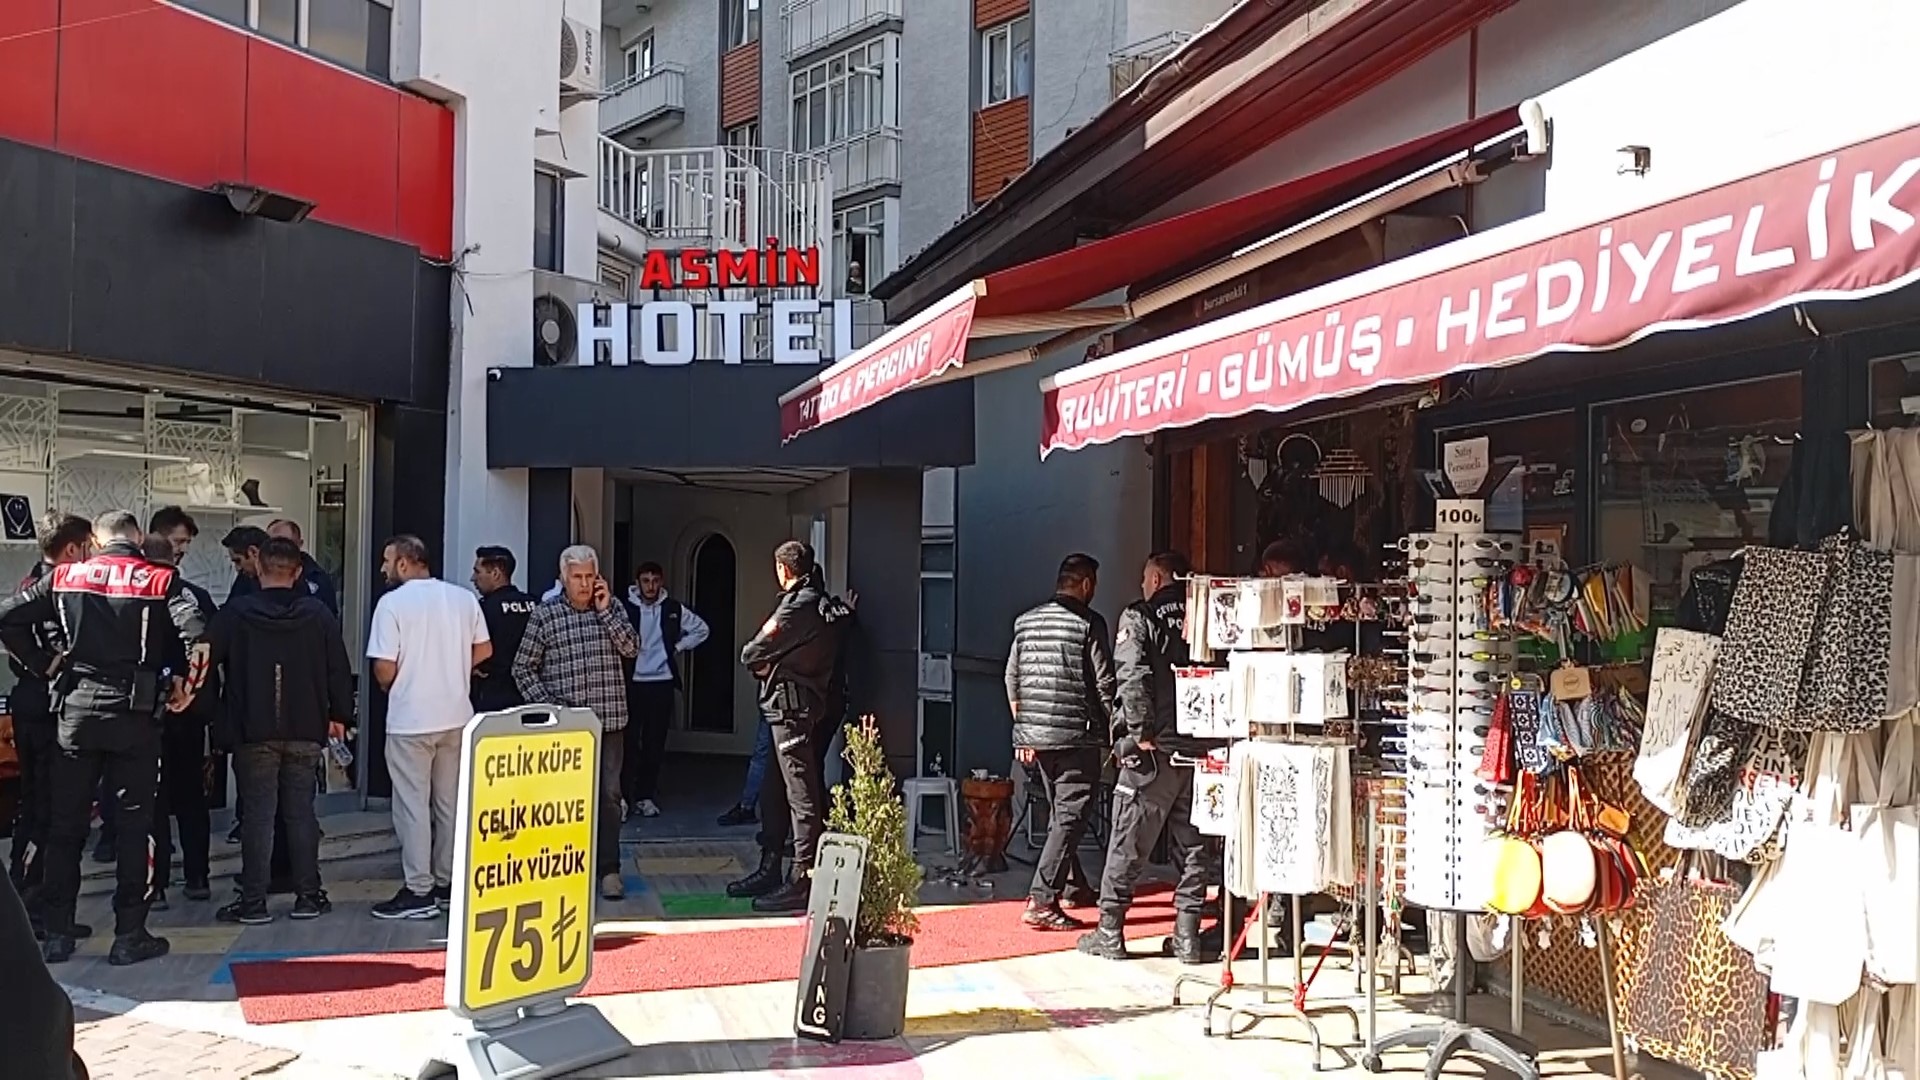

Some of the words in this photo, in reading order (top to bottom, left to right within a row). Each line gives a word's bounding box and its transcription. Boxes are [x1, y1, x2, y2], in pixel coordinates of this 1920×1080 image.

[640, 236, 819, 290] ASMİN
[1061, 353, 1190, 433] BUJİTERİ
[1218, 310, 1383, 400] GÜMÜŞ
[1436, 156, 1920, 353] HEDİYELİK
[577, 299, 860, 367] HOTEL
[853, 330, 933, 398] PIERCING
[484, 744, 533, 787] ÇELİK
[537, 741, 583, 775] KÜPE
[478, 799, 528, 842] ÇELİK
[531, 799, 585, 829] KOLYE
[474, 853, 523, 898] ÇELİK
[527, 844, 586, 881] YÜZÜK
